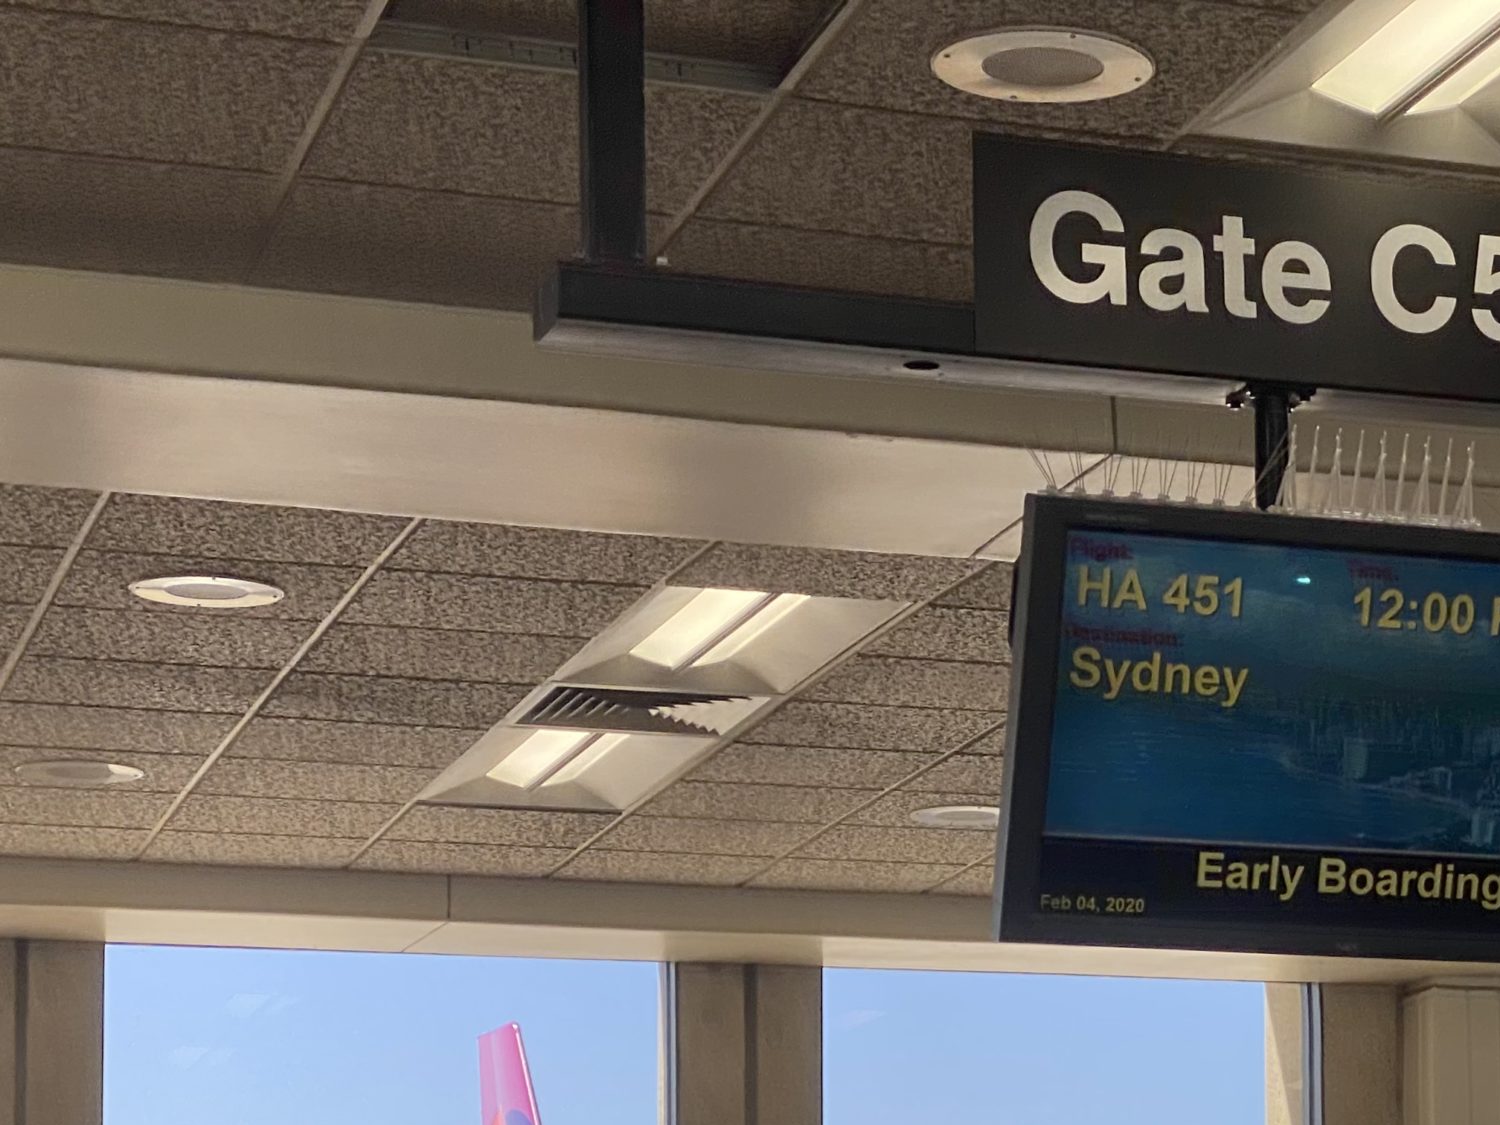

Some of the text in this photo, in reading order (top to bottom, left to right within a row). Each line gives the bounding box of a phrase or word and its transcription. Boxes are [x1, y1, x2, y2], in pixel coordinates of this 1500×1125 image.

[1029, 189, 1332, 324] Gate
[1076, 565, 1243, 618] HA 451
[1353, 586, 1475, 635] 12:00
[1069, 645, 1249, 708] Sydney
[1196, 850, 1305, 901] Early
[1040, 894, 1145, 914] Feb 04, 2020
